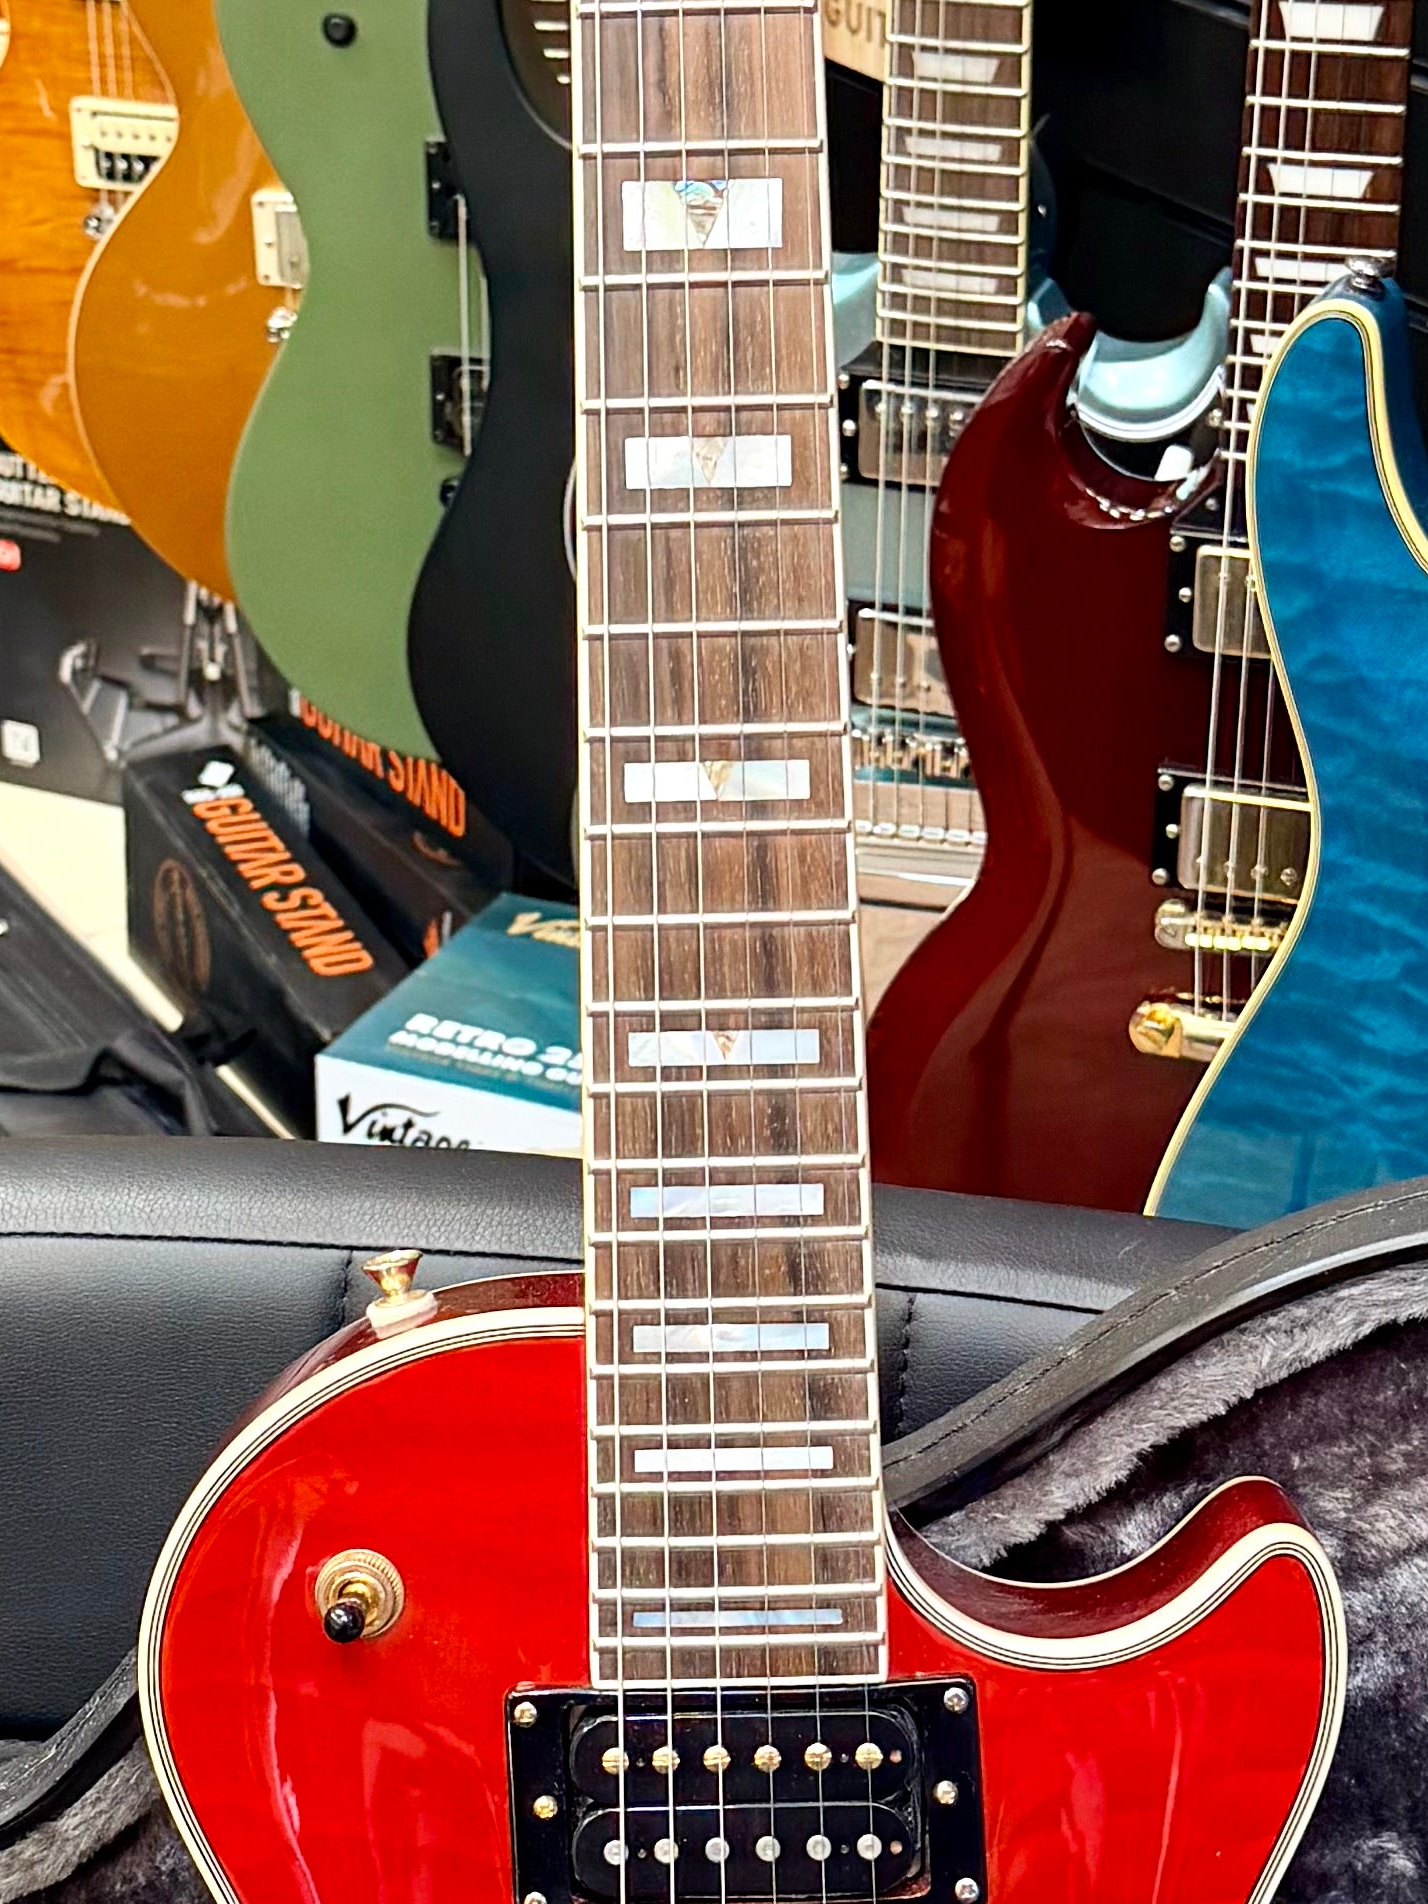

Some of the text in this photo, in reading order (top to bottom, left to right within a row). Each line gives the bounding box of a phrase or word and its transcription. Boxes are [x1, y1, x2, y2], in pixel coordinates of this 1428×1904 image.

[192, 796, 305, 892] GUITAR
[262, 886, 374, 978] STAND
[404, 1012, 537, 1057] RETRO
